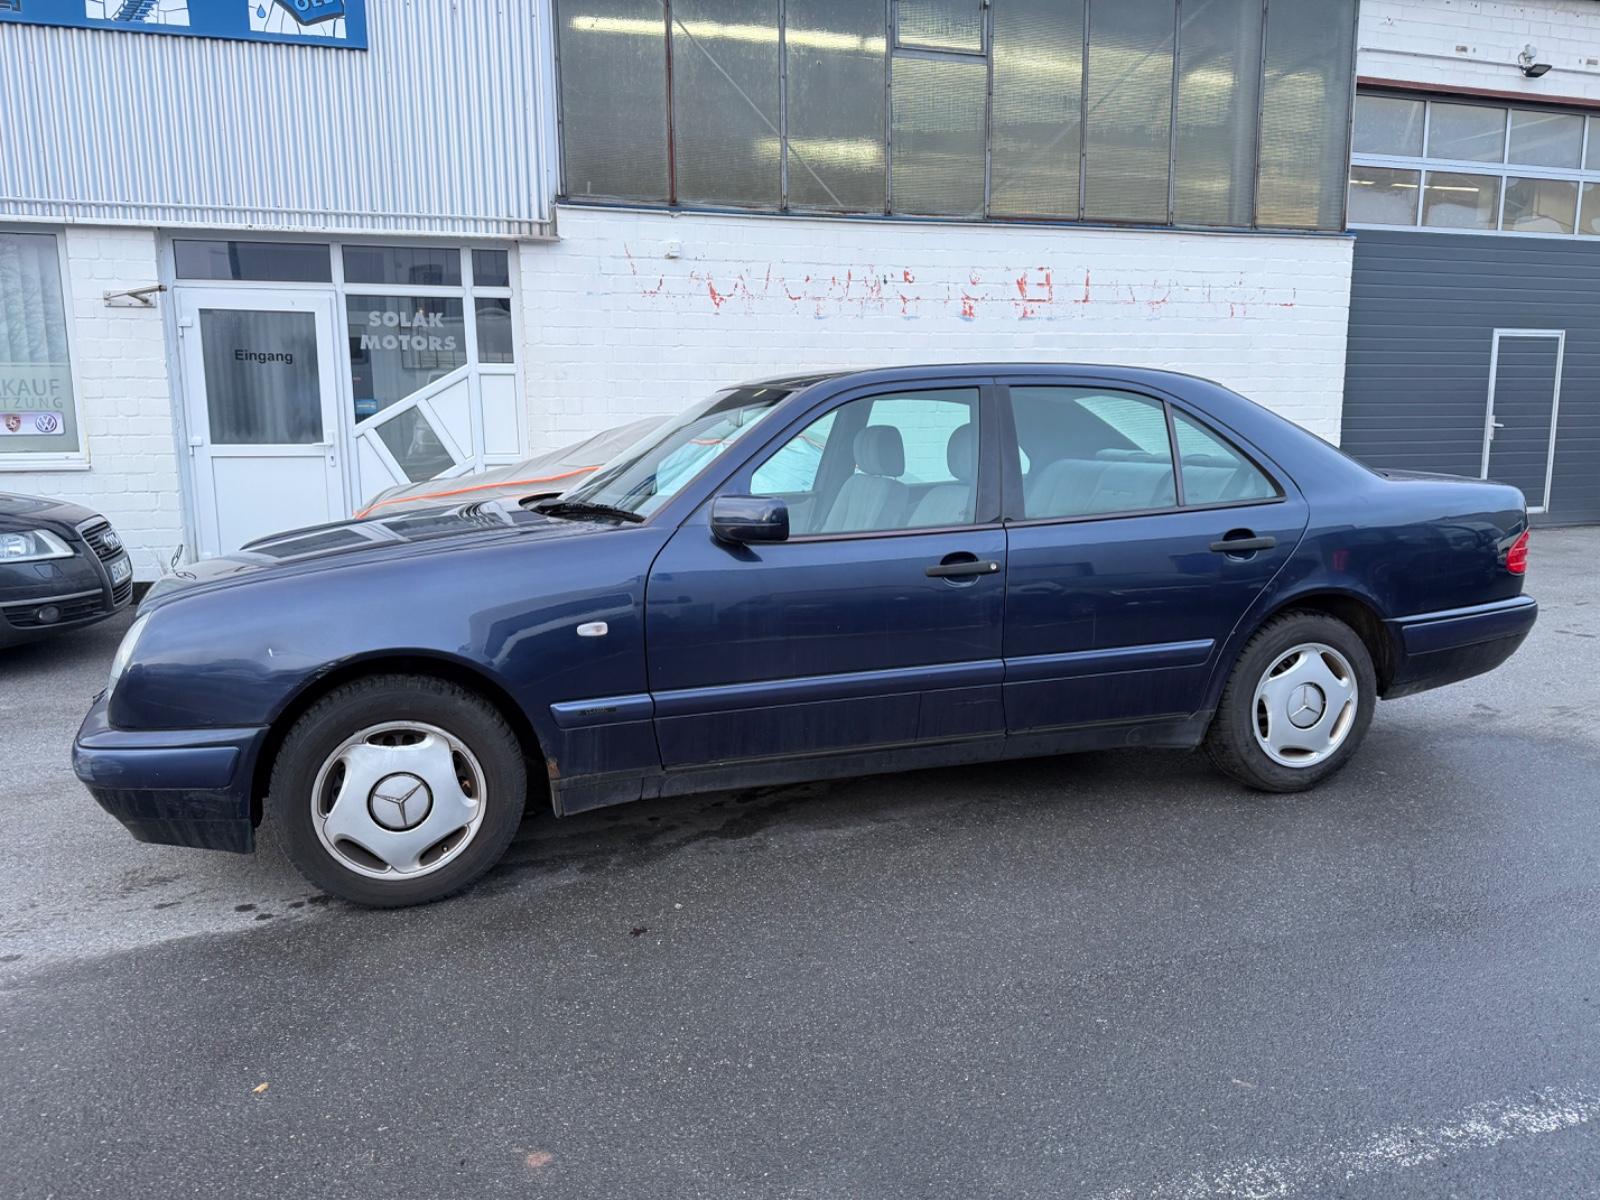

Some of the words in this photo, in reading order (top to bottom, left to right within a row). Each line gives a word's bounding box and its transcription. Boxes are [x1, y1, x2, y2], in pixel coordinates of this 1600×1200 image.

[369, 311, 444, 327] SOLAK
[360, 334, 457, 351] MOTORS
[234, 349, 293, 364] Eingang
[0, 378, 60, 396] KAUF
